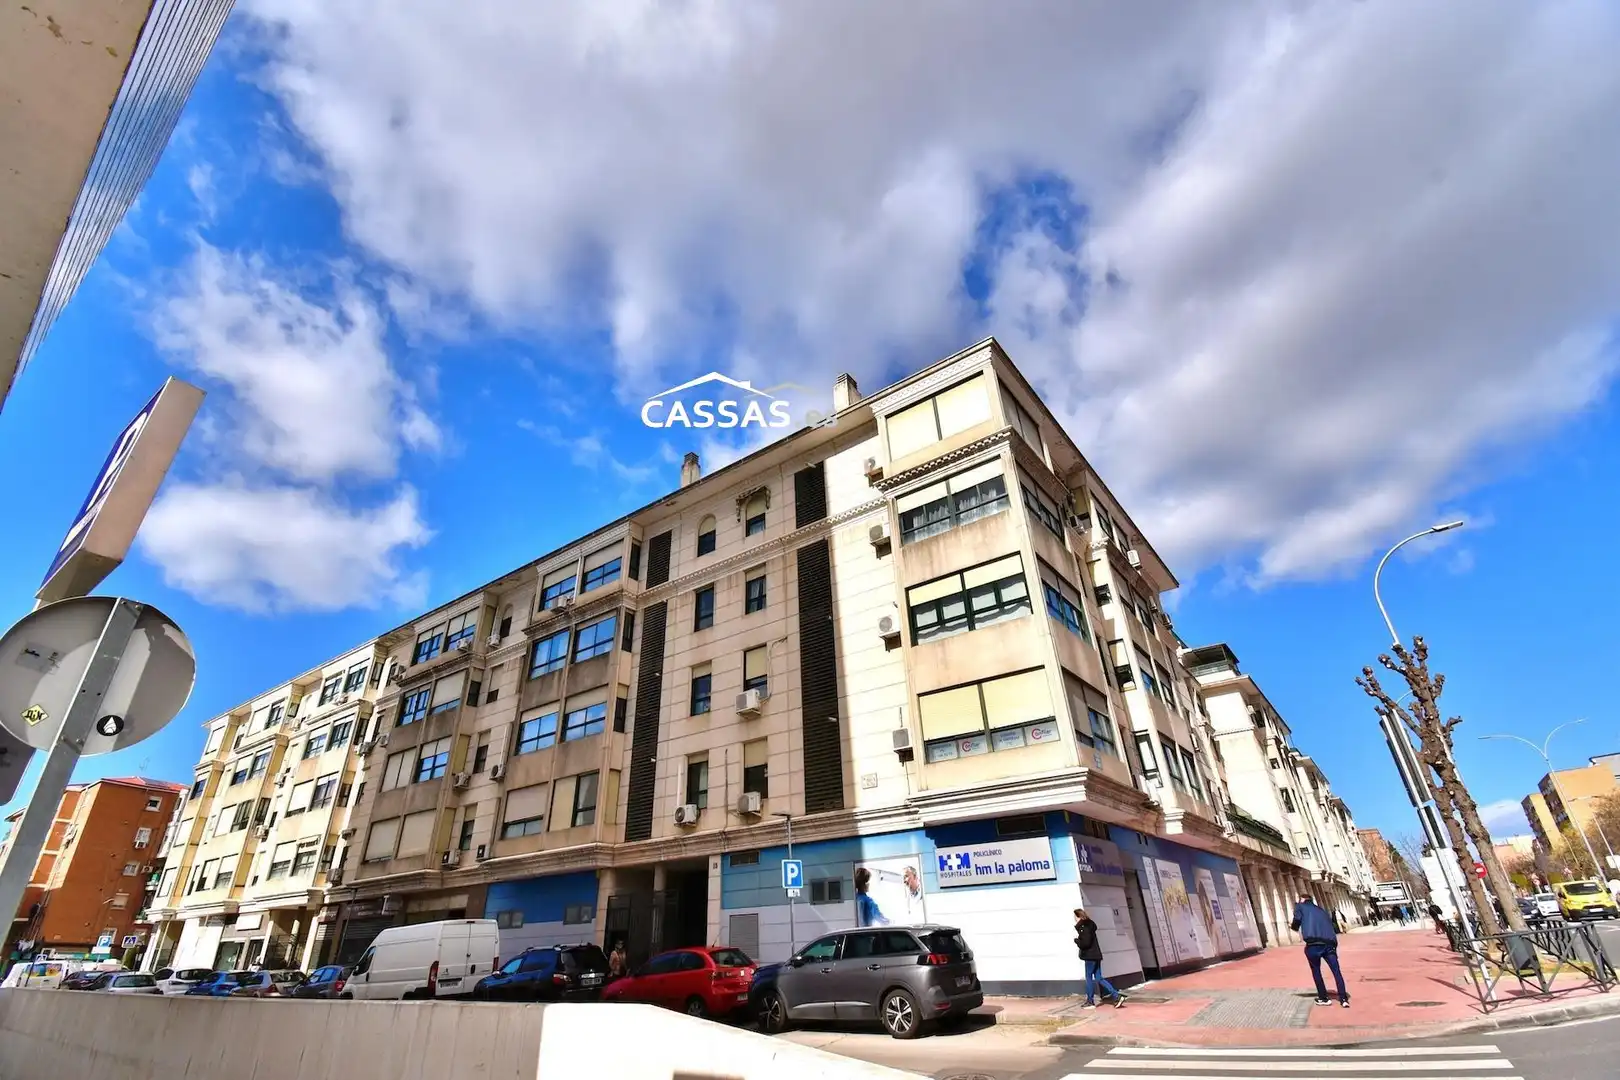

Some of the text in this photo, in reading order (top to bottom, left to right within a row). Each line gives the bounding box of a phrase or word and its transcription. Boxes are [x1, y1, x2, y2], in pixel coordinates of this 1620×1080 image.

[973, 848, 1003, 858] POLICLÍNICO
[786, 862, 799, 886] P
[940, 869, 972, 878] HOSPITALES
[974, 859, 1050, 876] hm la paloma
